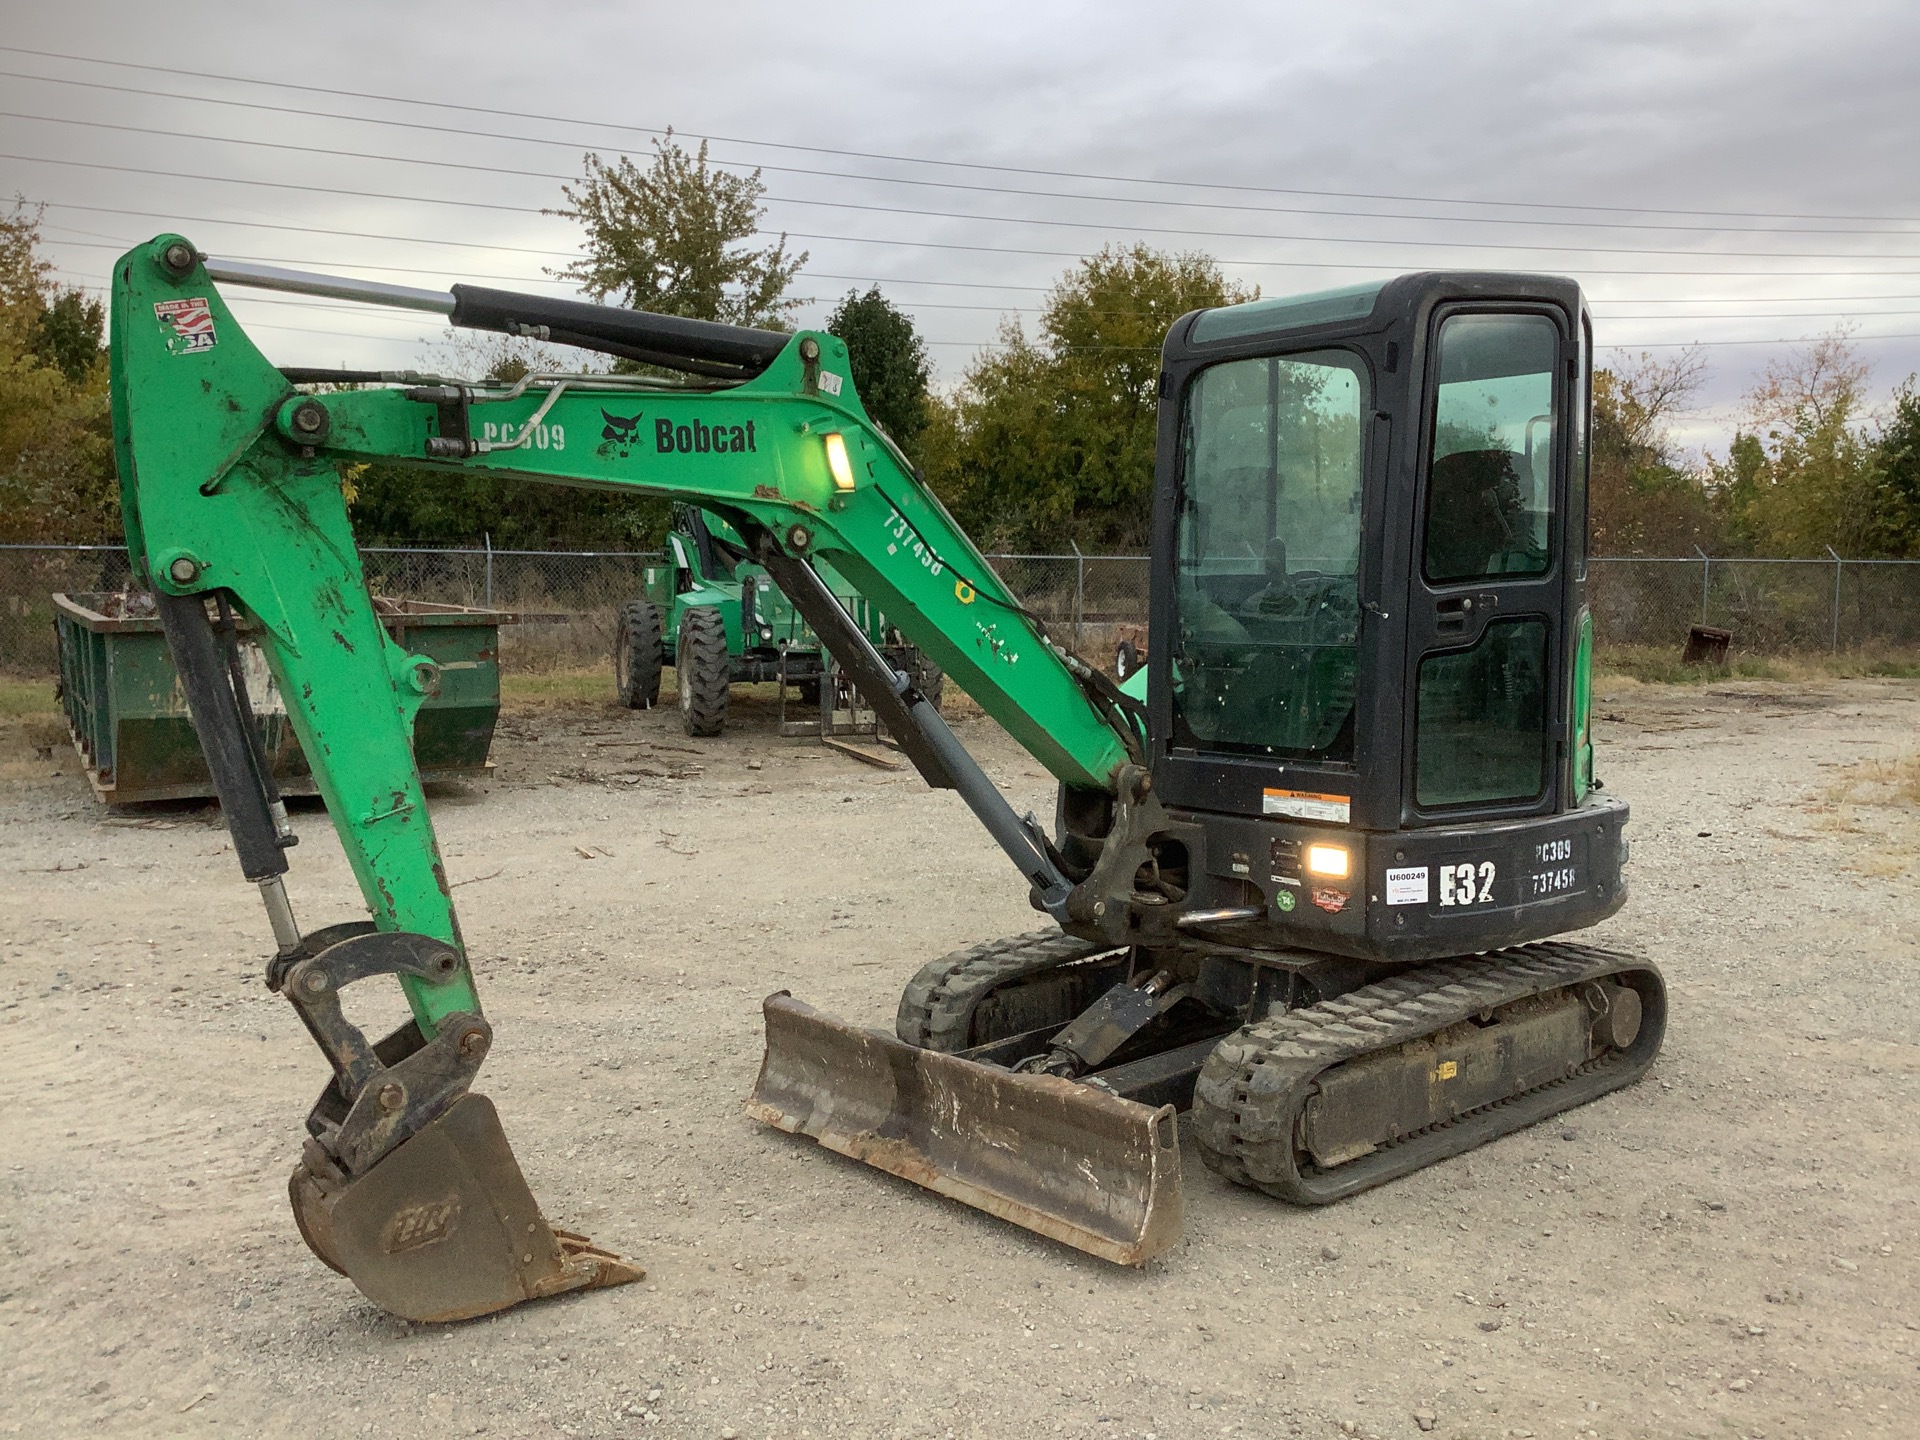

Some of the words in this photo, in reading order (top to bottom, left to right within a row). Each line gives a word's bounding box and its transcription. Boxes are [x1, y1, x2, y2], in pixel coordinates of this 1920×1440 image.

[157, 303, 180, 311] MADE
[191, 300, 204, 308] THE
[167, 333, 214, 349] SA
[655, 418, 757, 453] Bobcat
[1535, 839, 1571, 862] PC309
[1390, 872, 1426, 881] U600249
[1440, 861, 1496, 907] E32
